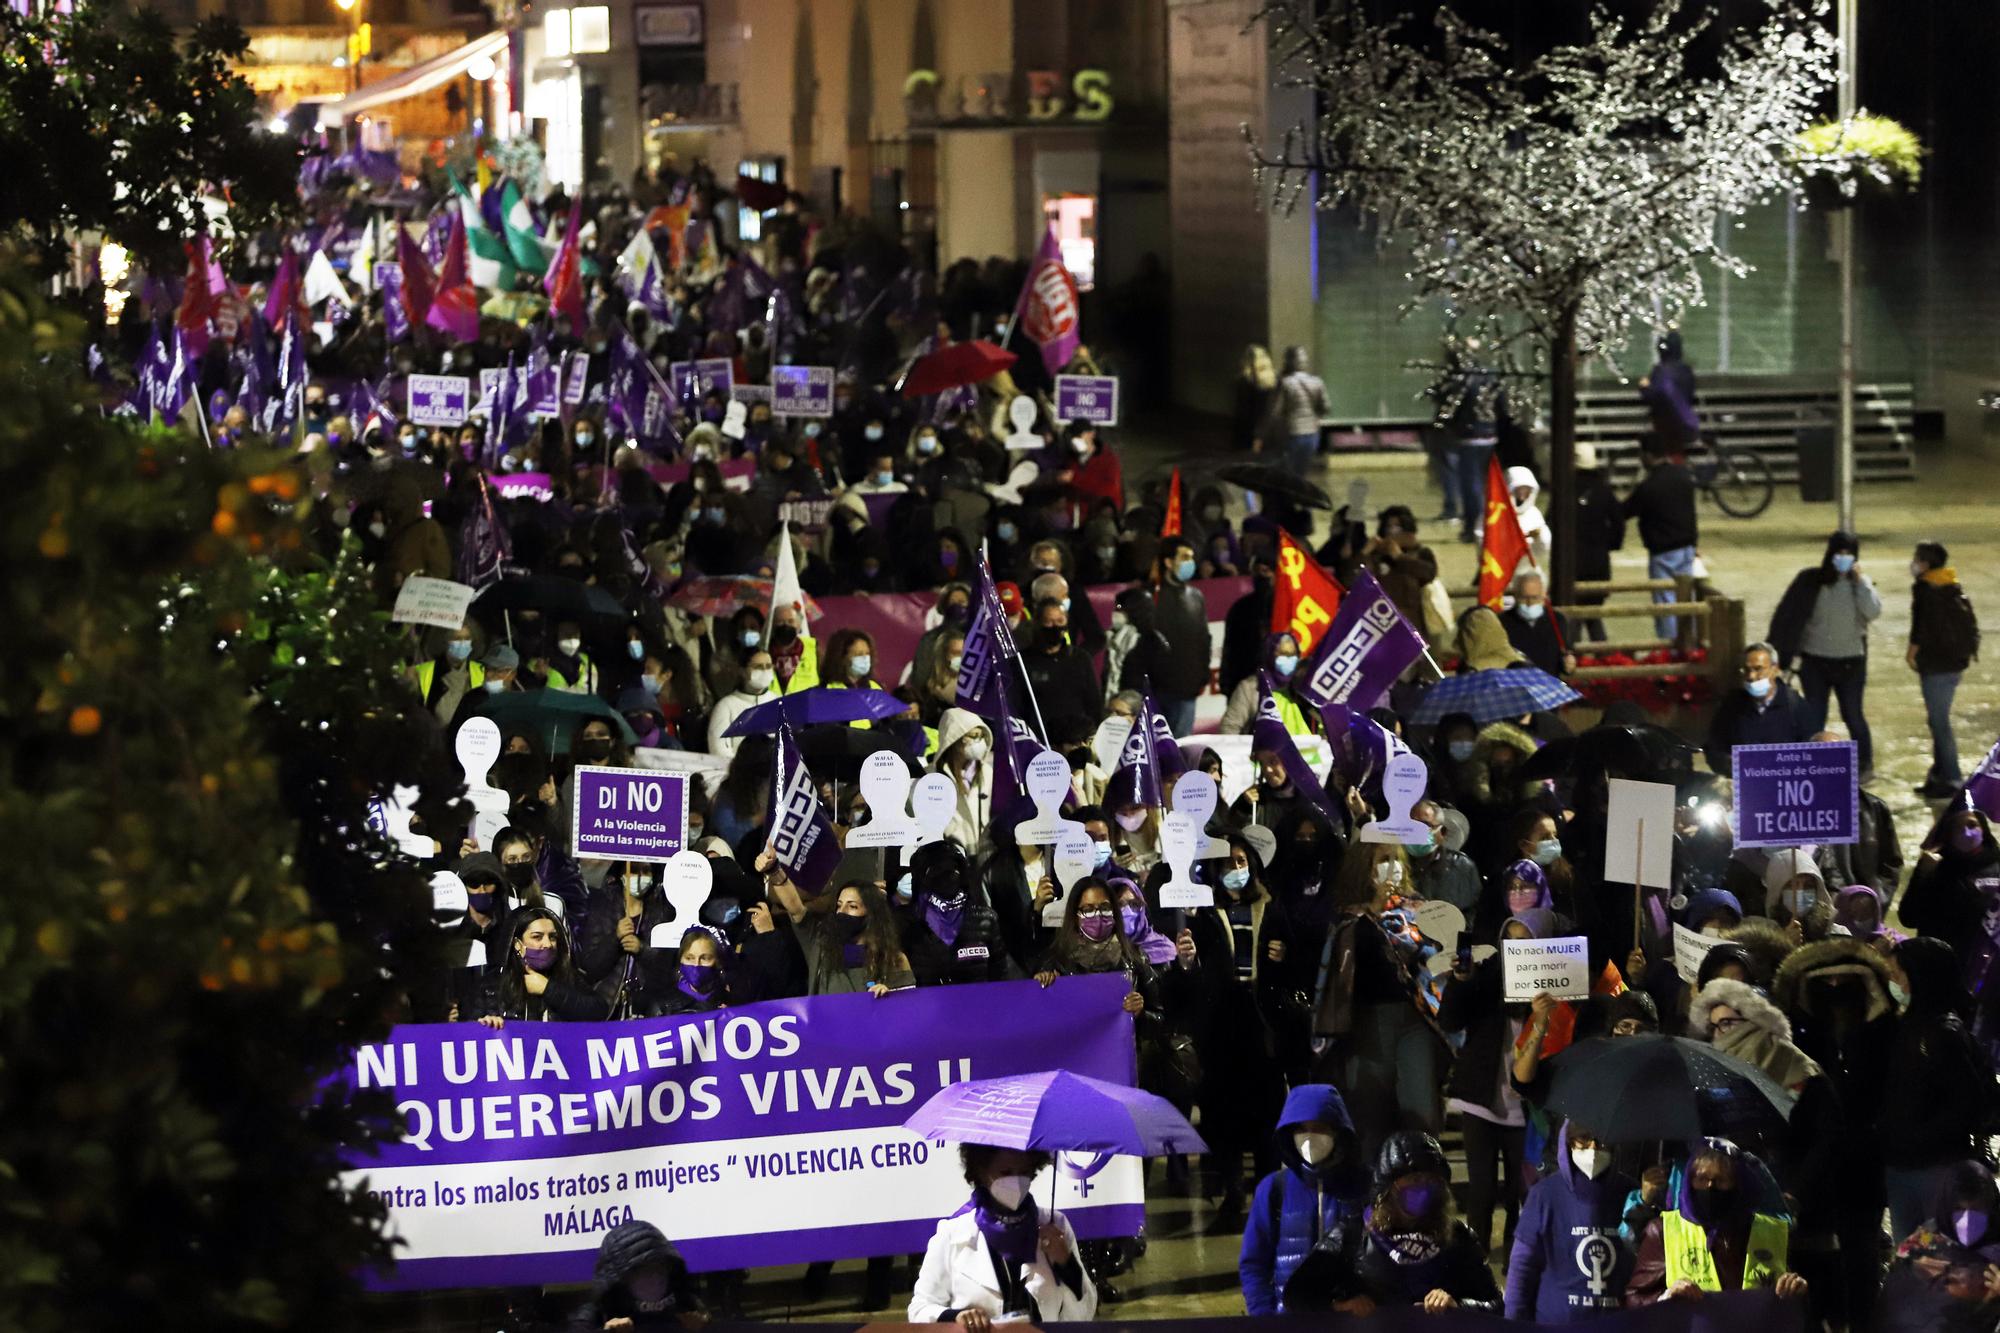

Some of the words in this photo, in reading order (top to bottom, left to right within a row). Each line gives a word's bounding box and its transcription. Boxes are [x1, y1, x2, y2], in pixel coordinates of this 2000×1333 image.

[1775, 752, 1801, 762] Ante
[1803, 752, 1812, 761] la
[1744, 766, 1792, 777] Violencia
[1793, 766, 1807, 776] de
[1808, 764, 1847, 775] Género
[599, 786, 617, 810] DI
[627, 781, 663, 813] NO
[1777, 780, 1814, 806] ¡NO
[594, 818, 602, 828] A
[604, 818, 614, 829] la
[616, 819, 666, 832] Violencia
[1755, 812, 1774, 833] TE
[1777, 810, 1839, 833] CALLES!
[580, 834, 615, 844] contra
[617, 834, 632, 845] las
[635, 837, 679, 848] mujeres
[1507, 946, 1521, 956] No
[1546, 944, 1582, 954] MUJER
[1516, 963, 1538, 973] para
[1540, 961, 1567, 971] morir
[1514, 981, 1531, 991] por
[1533, 978, 1570, 989] SERLO
[356, 1043, 418, 1088] NI
[441, 1037, 570, 1085] UNA
[586, 1015, 801, 1080] MENOS
[396, 1076, 722, 1151] QUEREMOS
[740, 1062, 916, 1115] VIVAS
[434, 1181, 466, 1207] los
[474, 1176, 540, 1204] malos
[546, 1172, 610, 1199] tratos
[616, 1171, 628, 1192] a
[635, 1160, 720, 1193] mujeres
[744, 1145, 864, 1179] VIOLENCIA
[870, 1140, 929, 1168] CERO
[543, 1204, 635, 1237] MÁLAGA
